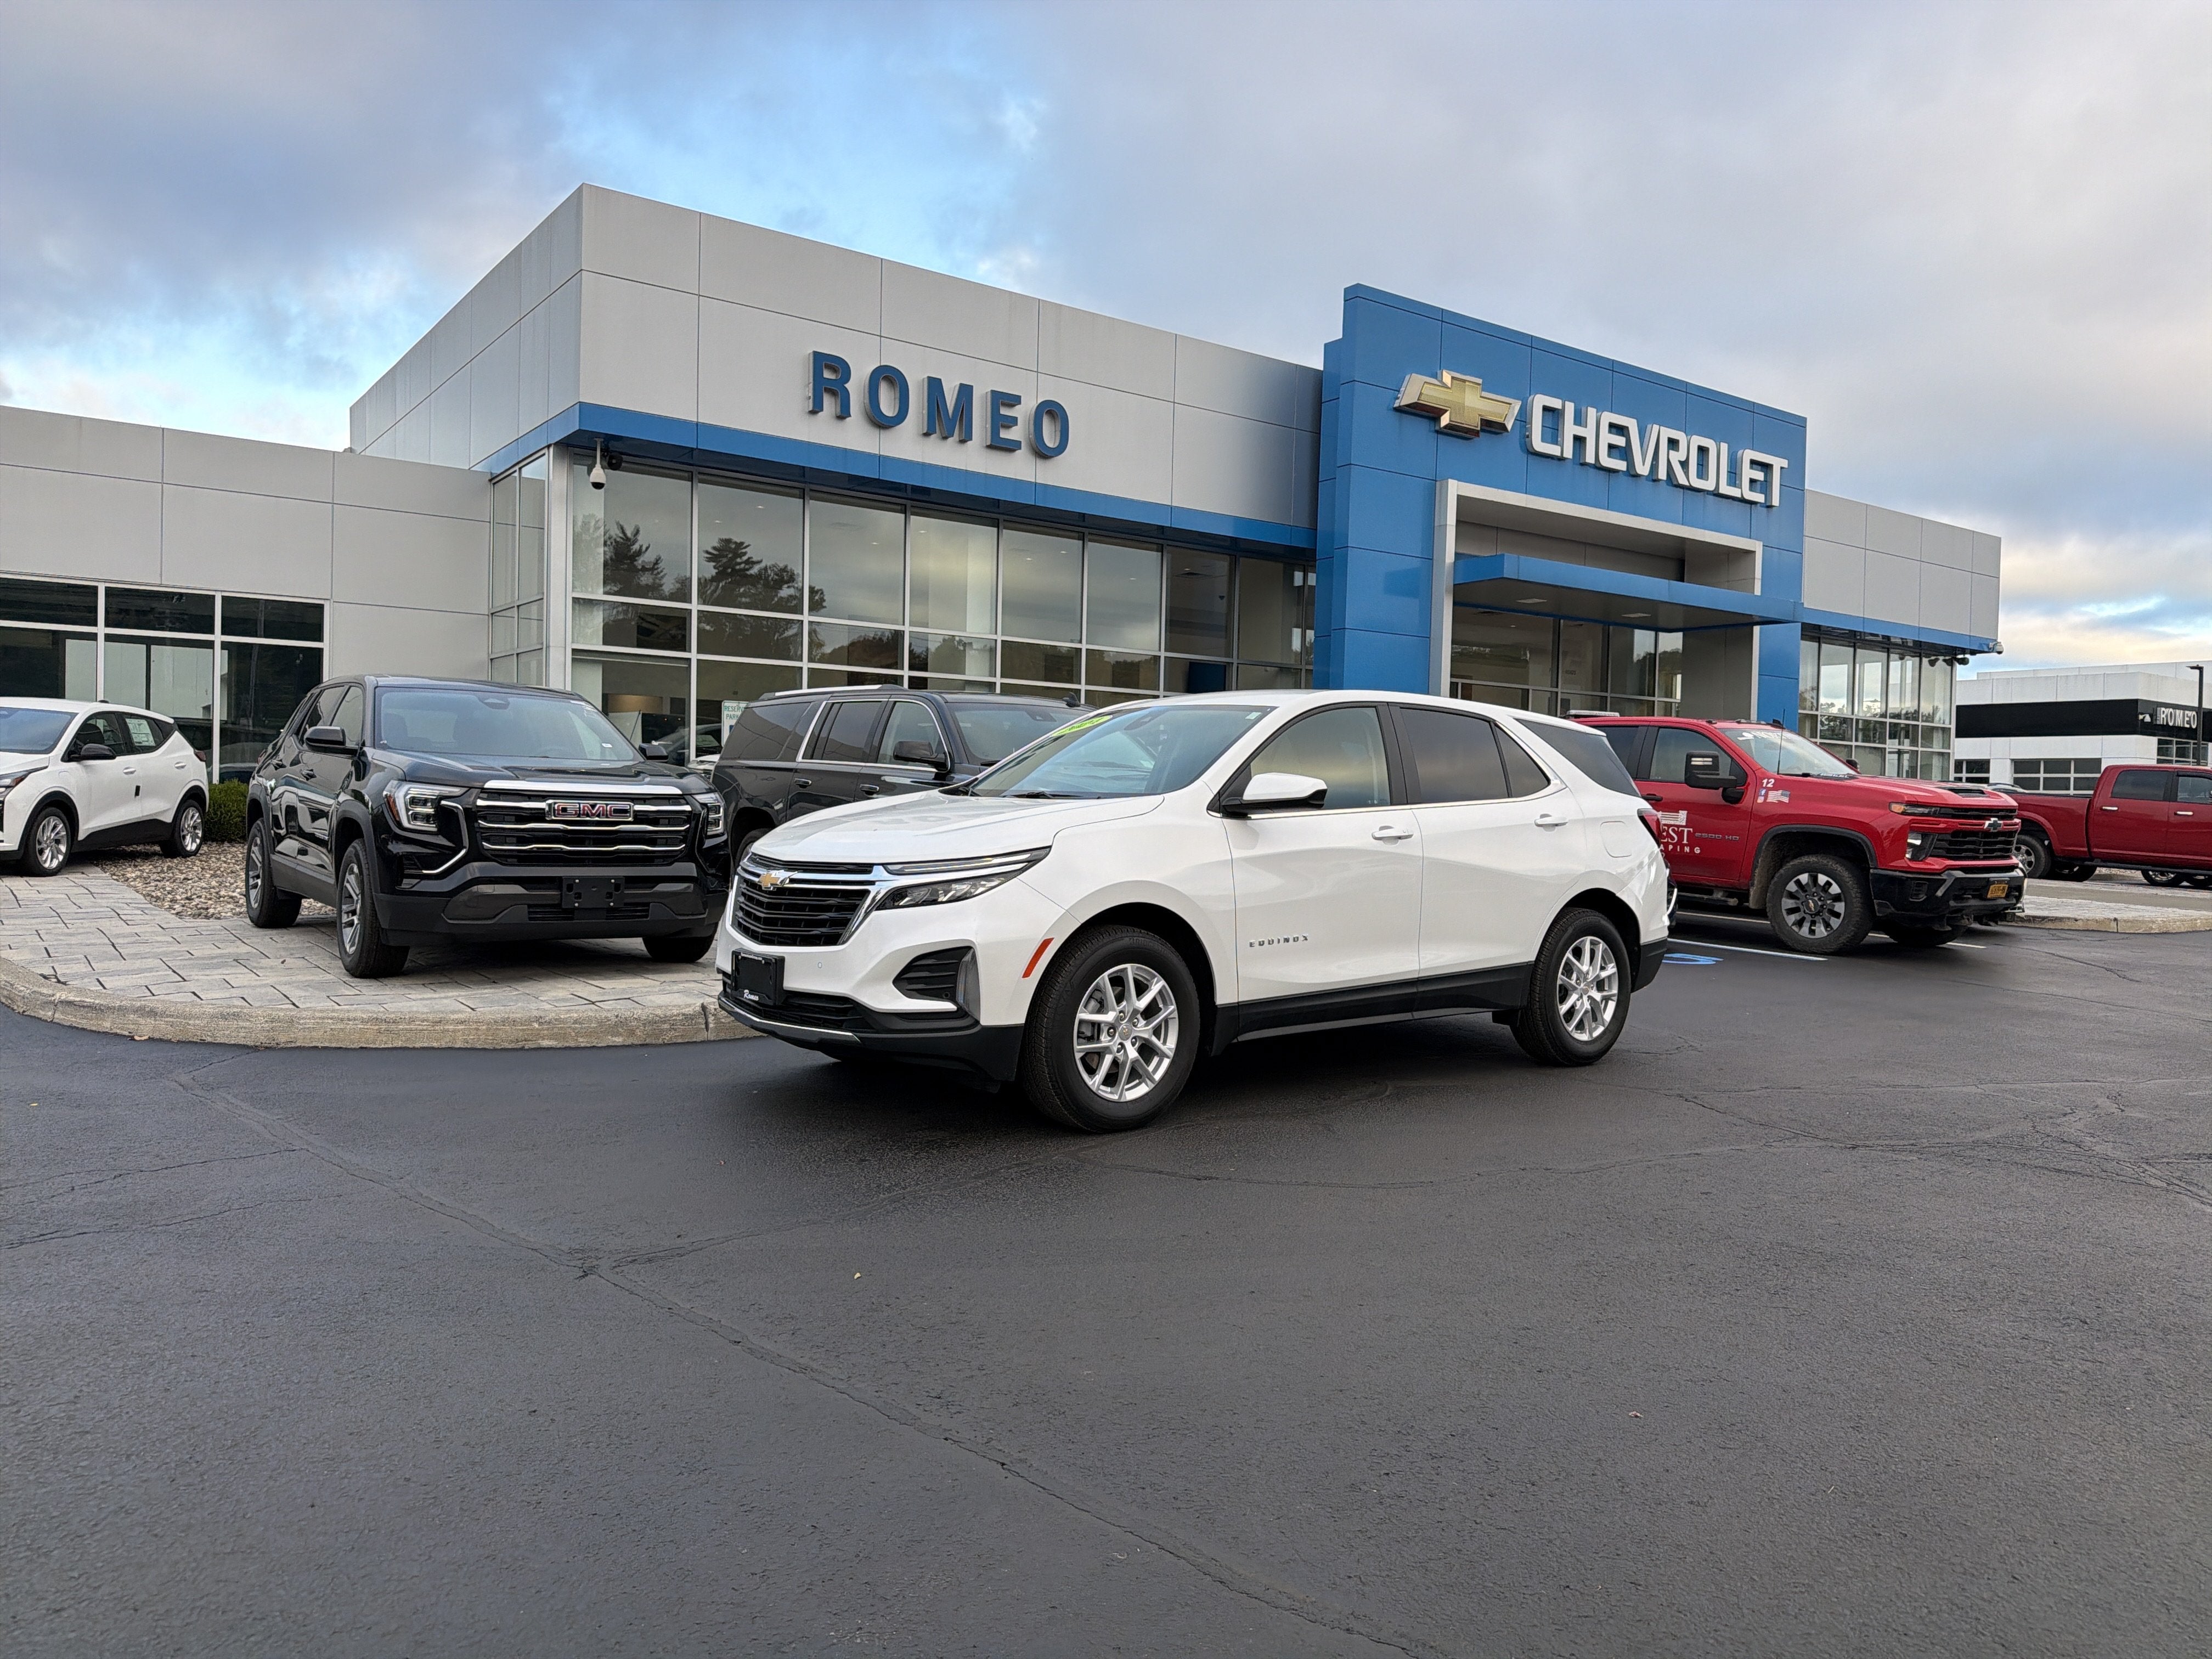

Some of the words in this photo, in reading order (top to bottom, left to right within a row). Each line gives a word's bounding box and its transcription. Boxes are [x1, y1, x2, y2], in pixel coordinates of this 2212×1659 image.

[809, 351, 1069, 458] ROMEO
[1527, 394, 1788, 507] CHEVROLET
[2159, 707, 2197, 729] ROMEO
[1762, 778, 1775, 787] 12
[555, 803, 630, 818] GMC
[1661, 826, 1692, 844] EST
[1660, 844, 1701, 854] APING
[1249, 934, 1308, 947] EQUINOX
